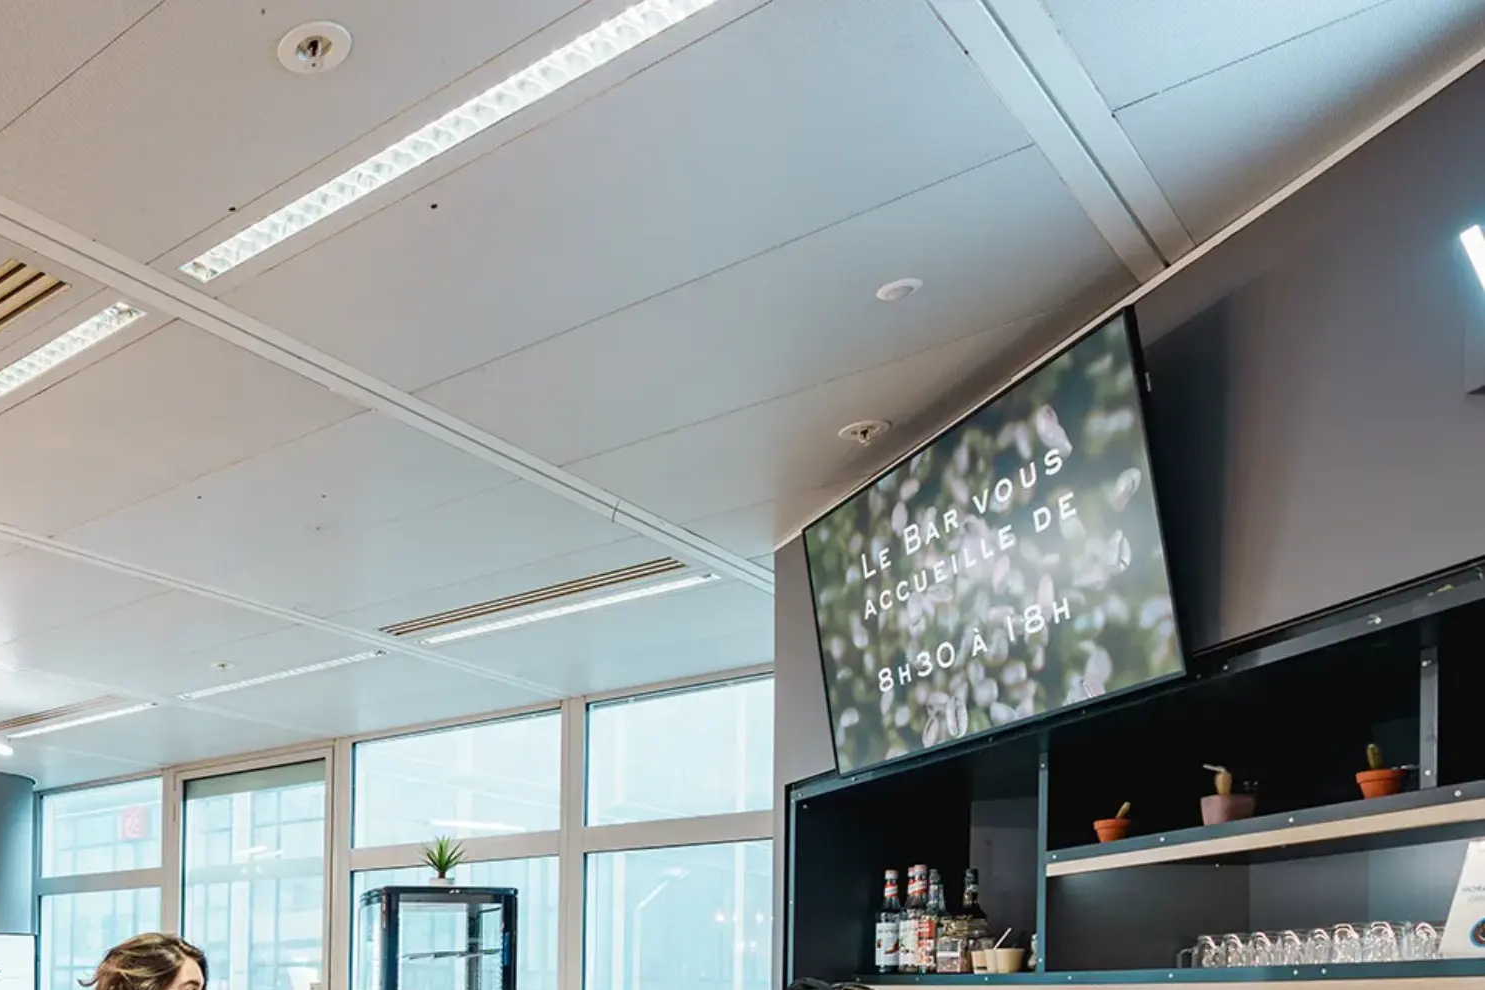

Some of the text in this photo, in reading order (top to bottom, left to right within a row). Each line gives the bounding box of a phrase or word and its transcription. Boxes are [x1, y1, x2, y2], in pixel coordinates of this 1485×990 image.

[972, 448, 1064, 514] VOUS
[864, 491, 1077, 620] ACCUEILLE DE
[878, 641, 955, 693] 8H30
[1005, 597, 1071, 642] 18H
